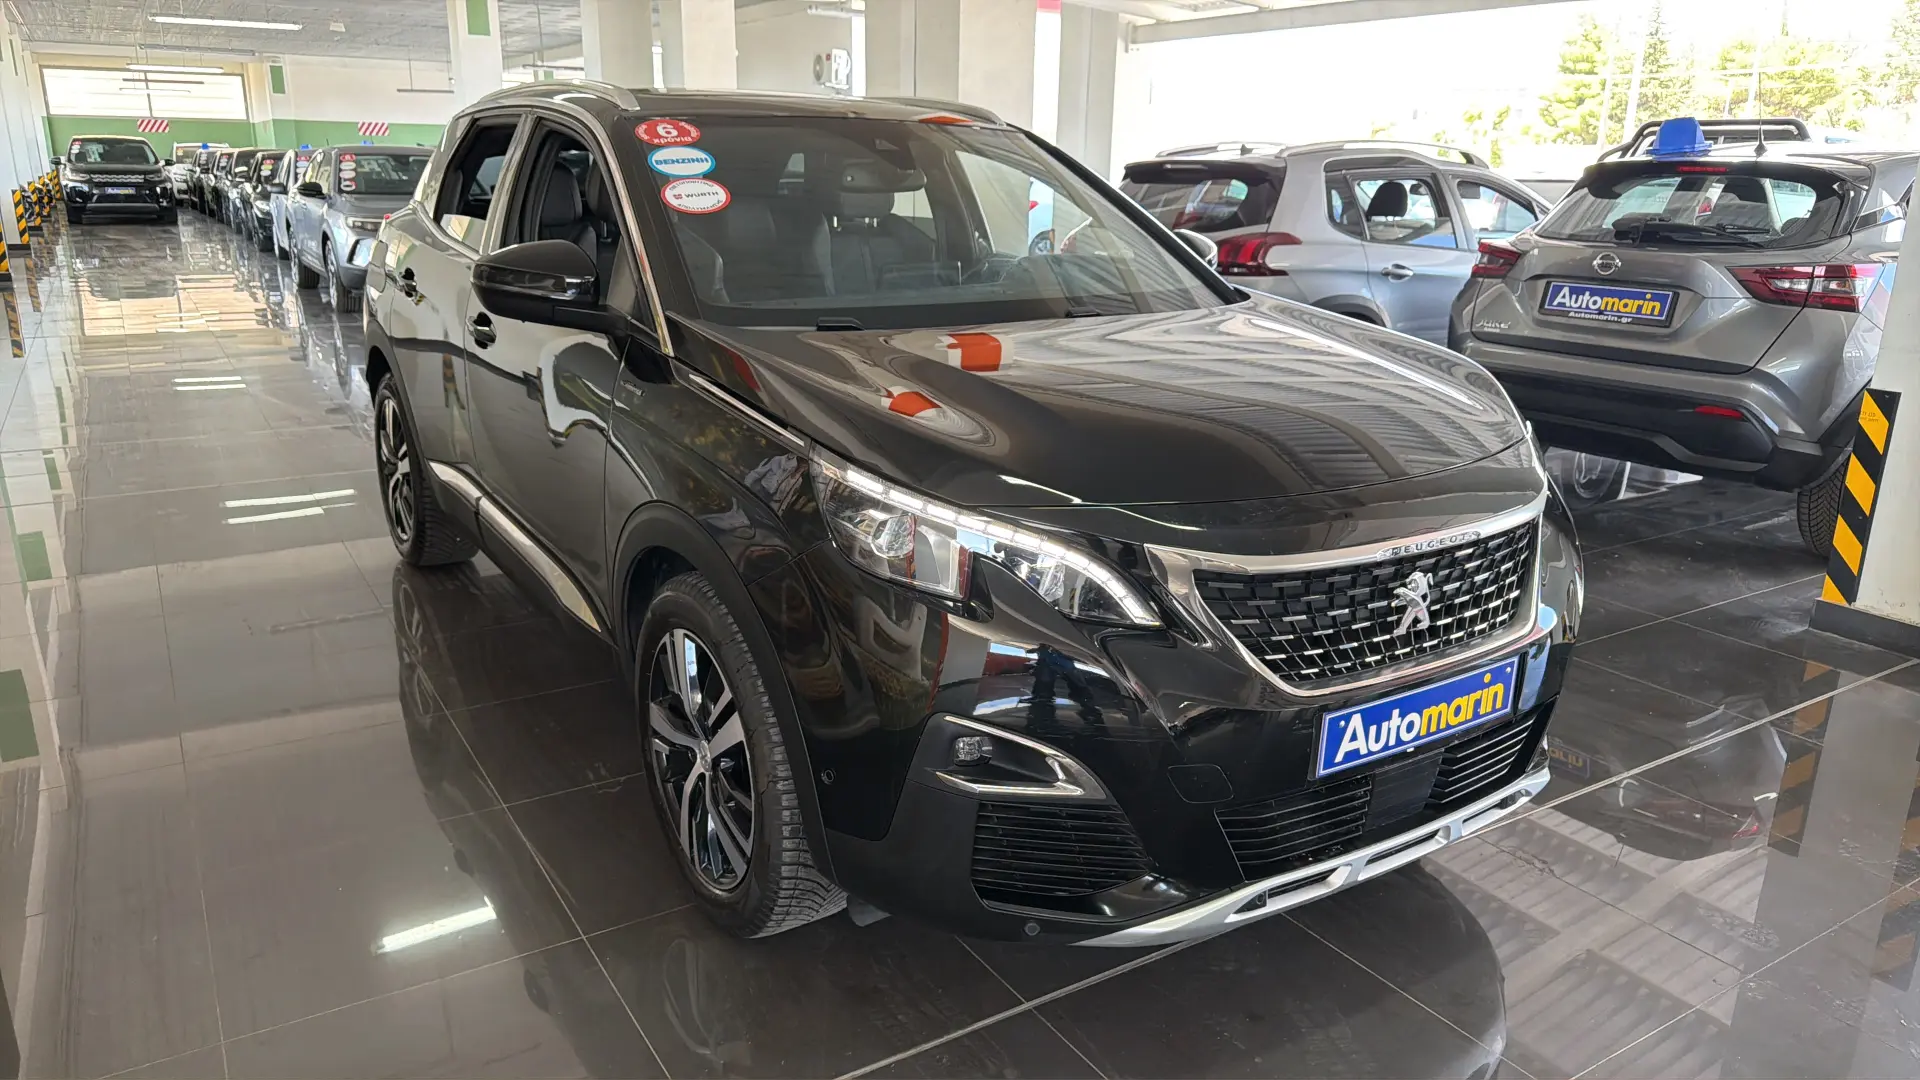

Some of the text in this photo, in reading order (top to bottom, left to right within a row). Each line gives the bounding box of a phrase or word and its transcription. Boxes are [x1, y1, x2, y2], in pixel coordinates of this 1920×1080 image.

[656, 122, 678, 137] 6
[1552, 287, 1661, 315] Automarin
[1568, 311, 1633, 323] Automarin.gr
[1391, 533, 1468, 556] PEUGEOT
[1334, 672, 1504, 763] Automarin
